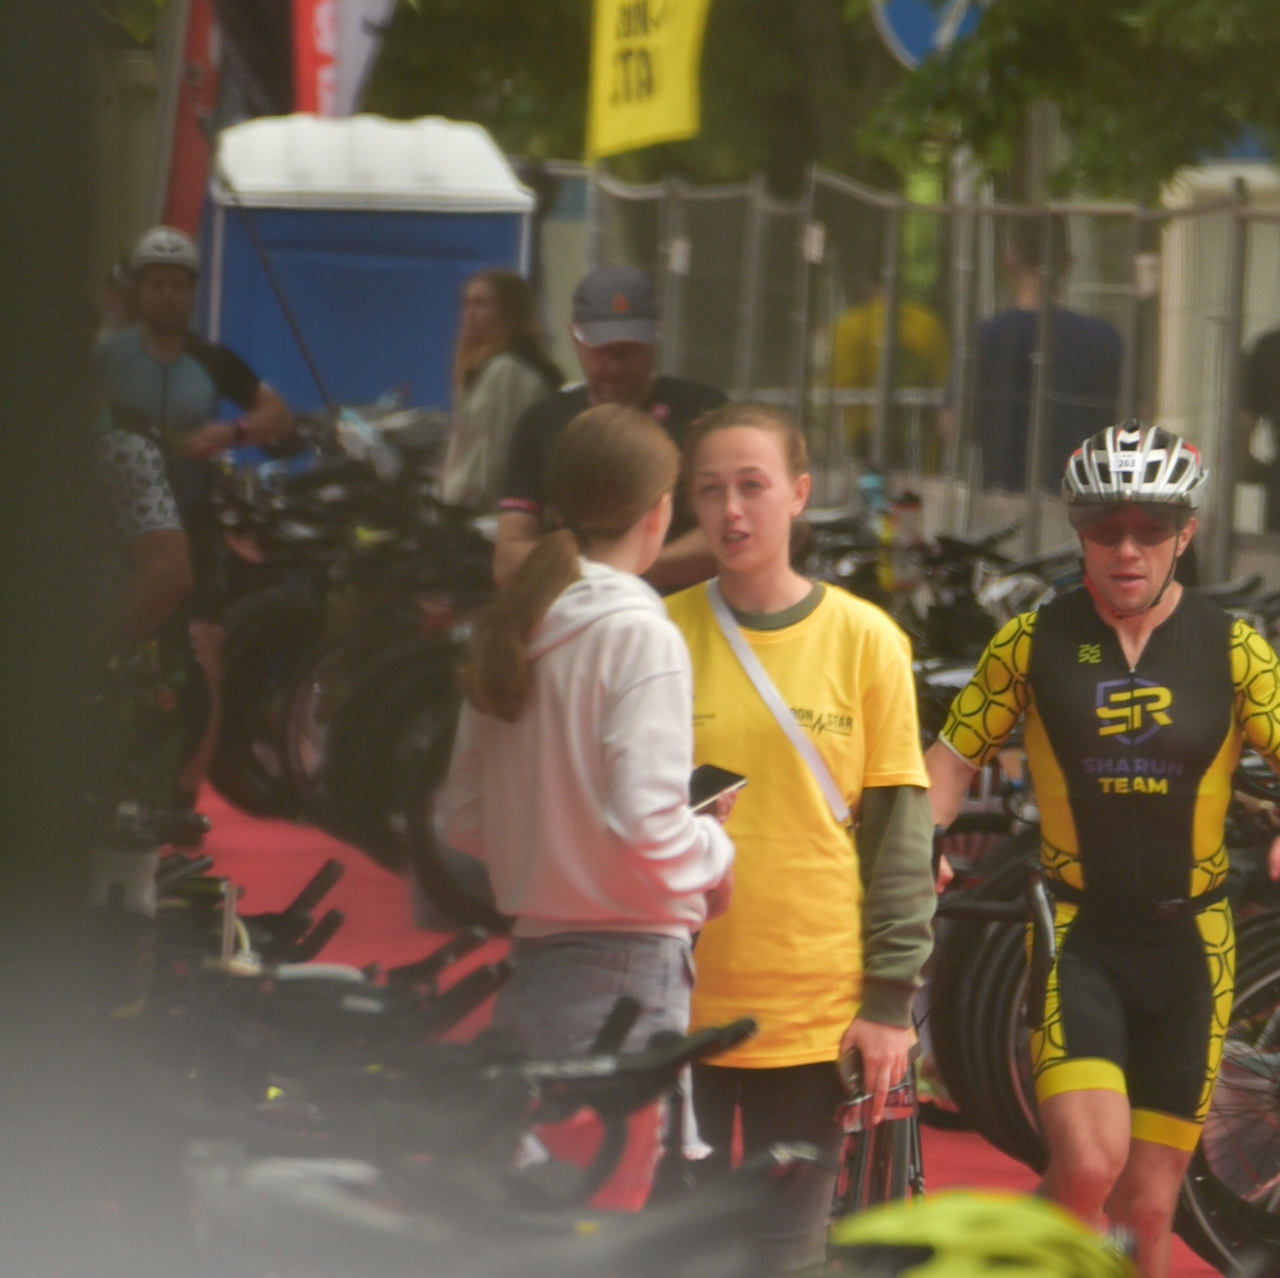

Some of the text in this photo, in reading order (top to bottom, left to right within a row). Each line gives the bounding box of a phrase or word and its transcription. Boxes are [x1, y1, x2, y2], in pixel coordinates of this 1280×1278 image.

[1117, 459, 1136, 468] 263
[826, 713, 854, 730] STAR
[1082, 757, 1183, 776] SHARUN
[1098, 777, 1168, 795] TEAM
